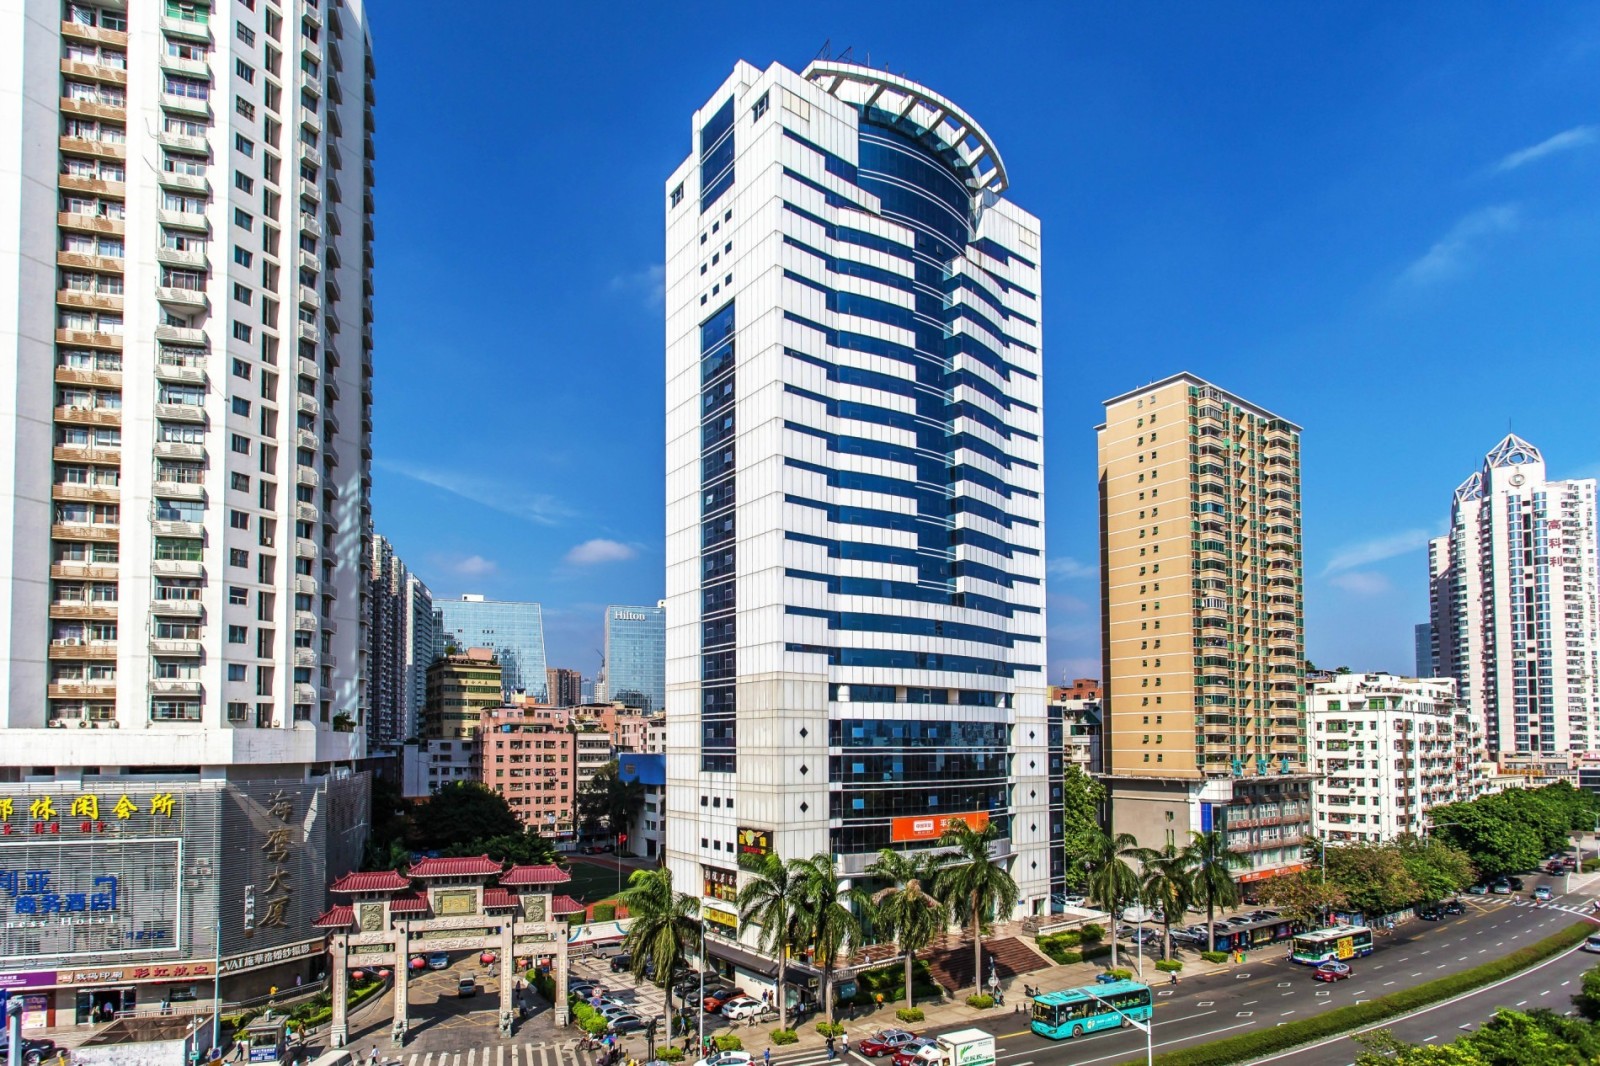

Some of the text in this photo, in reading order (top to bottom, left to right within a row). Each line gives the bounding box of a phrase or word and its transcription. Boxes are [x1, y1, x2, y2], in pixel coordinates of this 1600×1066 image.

[1548, 519, 1563, 567] 高科利
[614, 610, 645, 620] Hilton
[15, 888, 117, 914] 商务酒店
[60, 915, 115, 926] Hotel
